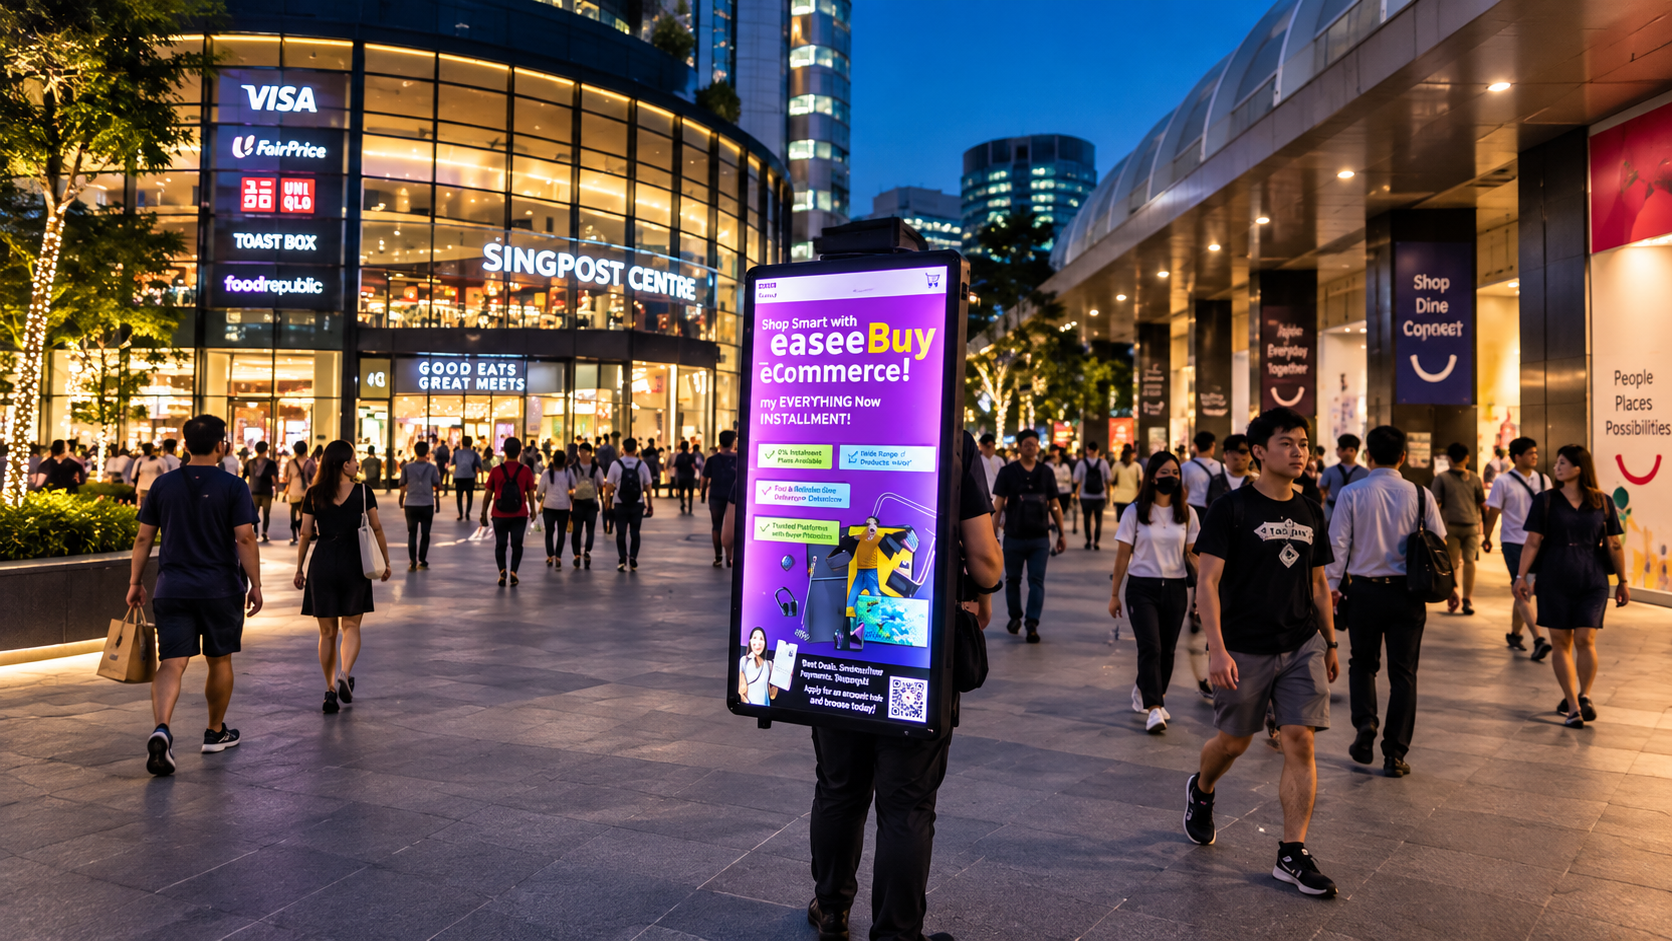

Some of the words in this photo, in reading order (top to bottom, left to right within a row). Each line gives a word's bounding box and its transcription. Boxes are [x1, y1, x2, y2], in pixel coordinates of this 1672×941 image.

[241, 84, 318, 113] VISA
[256, 140, 327, 159] FairPrice
[284, 181, 309, 195] UNI
[283, 195, 312, 212] QLO
[233, 233, 282, 249] TOAST
[284, 234, 317, 251] BOX
[482, 242, 625, 287] SINGPOST
[627, 265, 697, 301] CENTRE
[225, 275, 323, 296] foodrepublic
[1413, 273, 1450, 294] Shop
[1416, 297, 1449, 314] Dine
[762, 318, 789, 332] Shop
[792, 316, 828, 329] Smart
[831, 315, 858, 328] with
[1267, 343, 1308, 361] Everyday
[418, 361, 471, 376] GOOD
[477, 363, 517, 377] EATS
[759, 357, 910, 384] eCommerce!
[418, 377, 471, 391] GREAT
[476, 378, 526, 391] MEETS
[1614, 368, 1654, 389] People
[760, 398, 777, 411] my
[779, 396, 853, 408] EVERYTHING
[855, 396, 881, 407] Now
[1615, 394, 1653, 412] Places
[760, 413, 851, 425] INSTALLMENT!
[1605, 419, 1672, 436] Possibilities
[804, 684, 822, 695] Apply
[822, 685, 832, 695] for
[810, 697, 823, 706] and
[851, 702, 877, 715] today!
